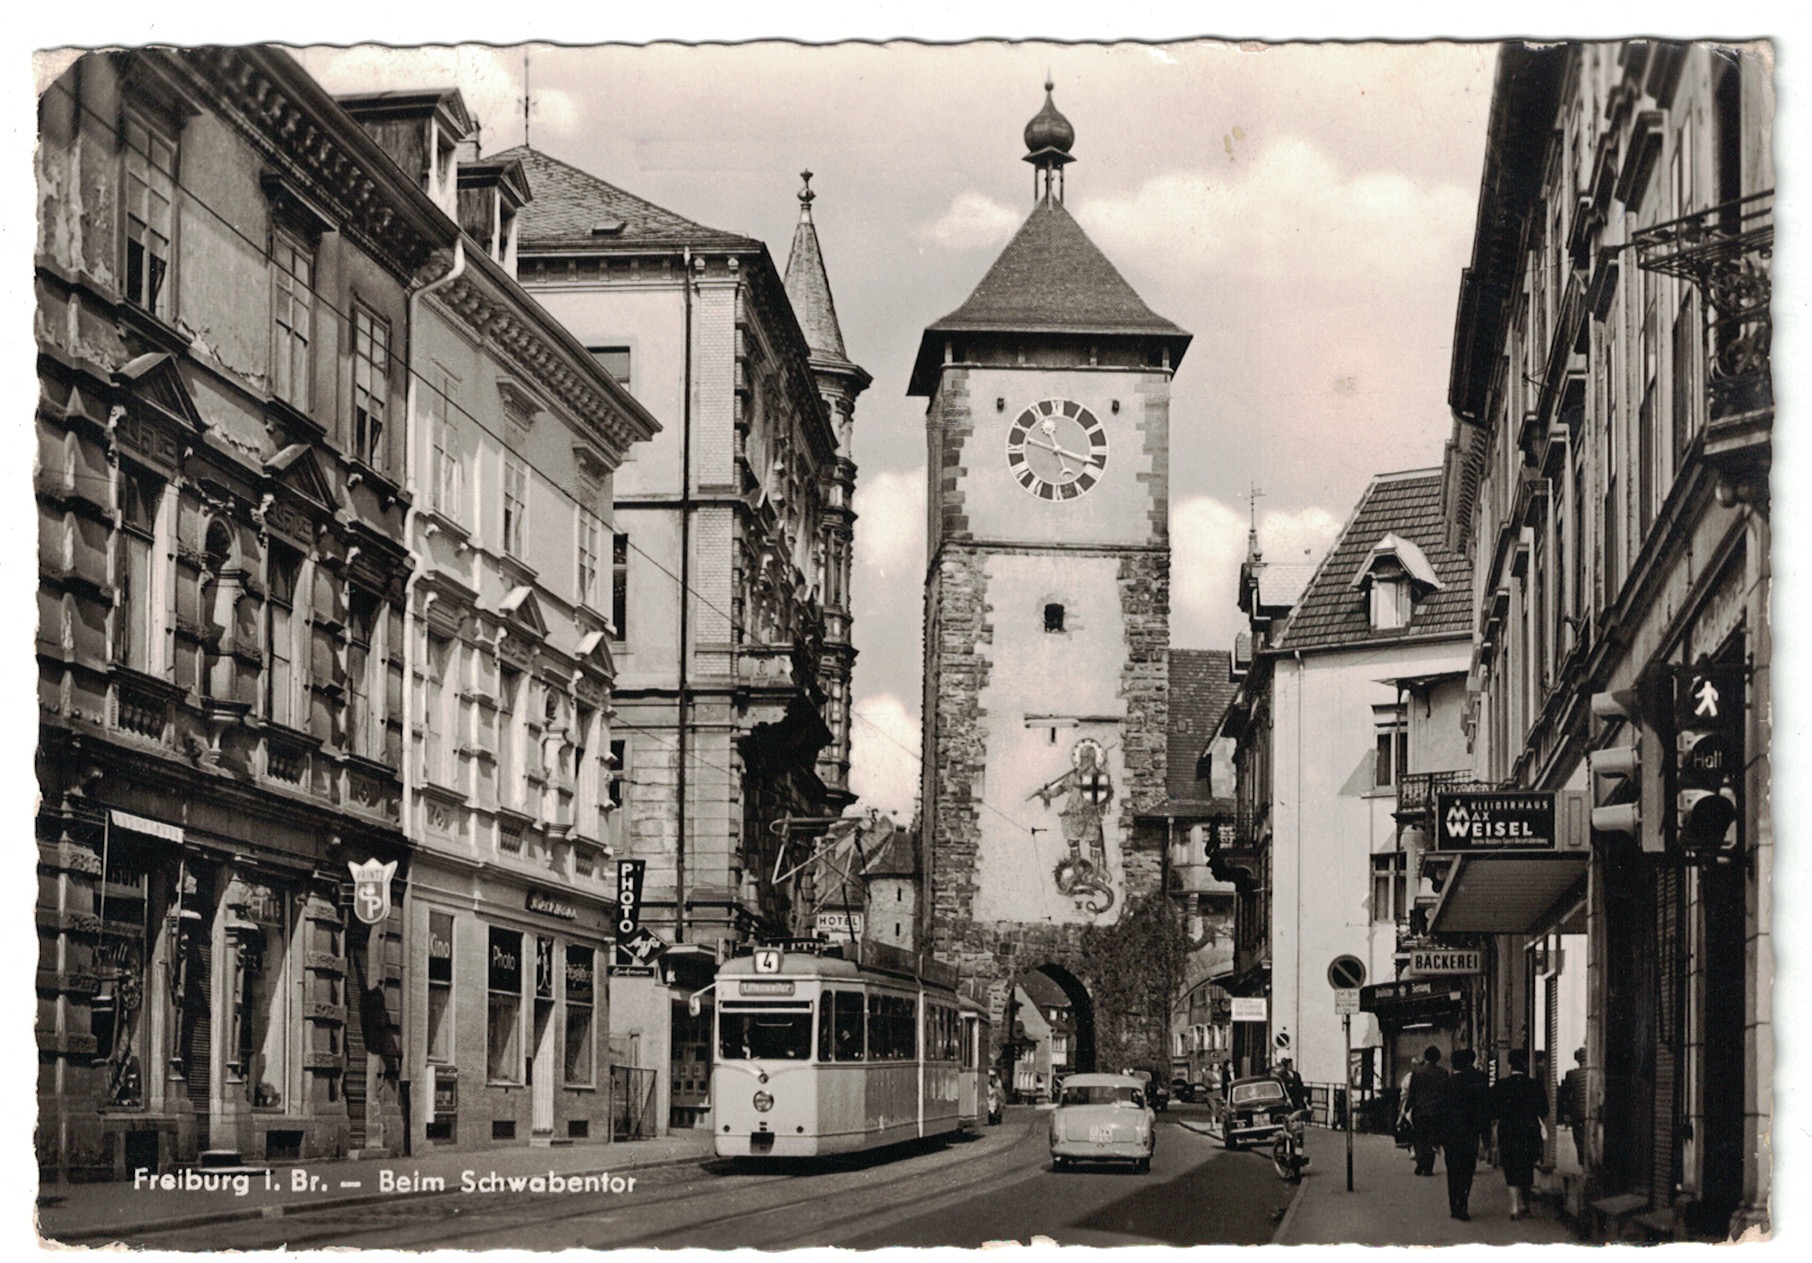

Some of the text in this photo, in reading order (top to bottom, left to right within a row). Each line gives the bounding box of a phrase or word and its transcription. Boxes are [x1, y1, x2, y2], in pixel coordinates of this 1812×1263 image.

[1693, 750, 1723, 769] Halt
[1446, 806, 1490, 821] MAX
[1470, 801, 1549, 811] KLEIDERHAUS
[1446, 821, 1534, 837] WEISEL
[619, 862, 635, 934] PHOTO
[819, 916, 858, 926] HOTEL
[429, 932, 451, 959] Kino
[626, 936, 661, 958] Agfa
[492, 945, 516, 971] Photo
[763, 951, 772, 969] 4
[1415, 953, 1478, 970] BÄCKEREI
